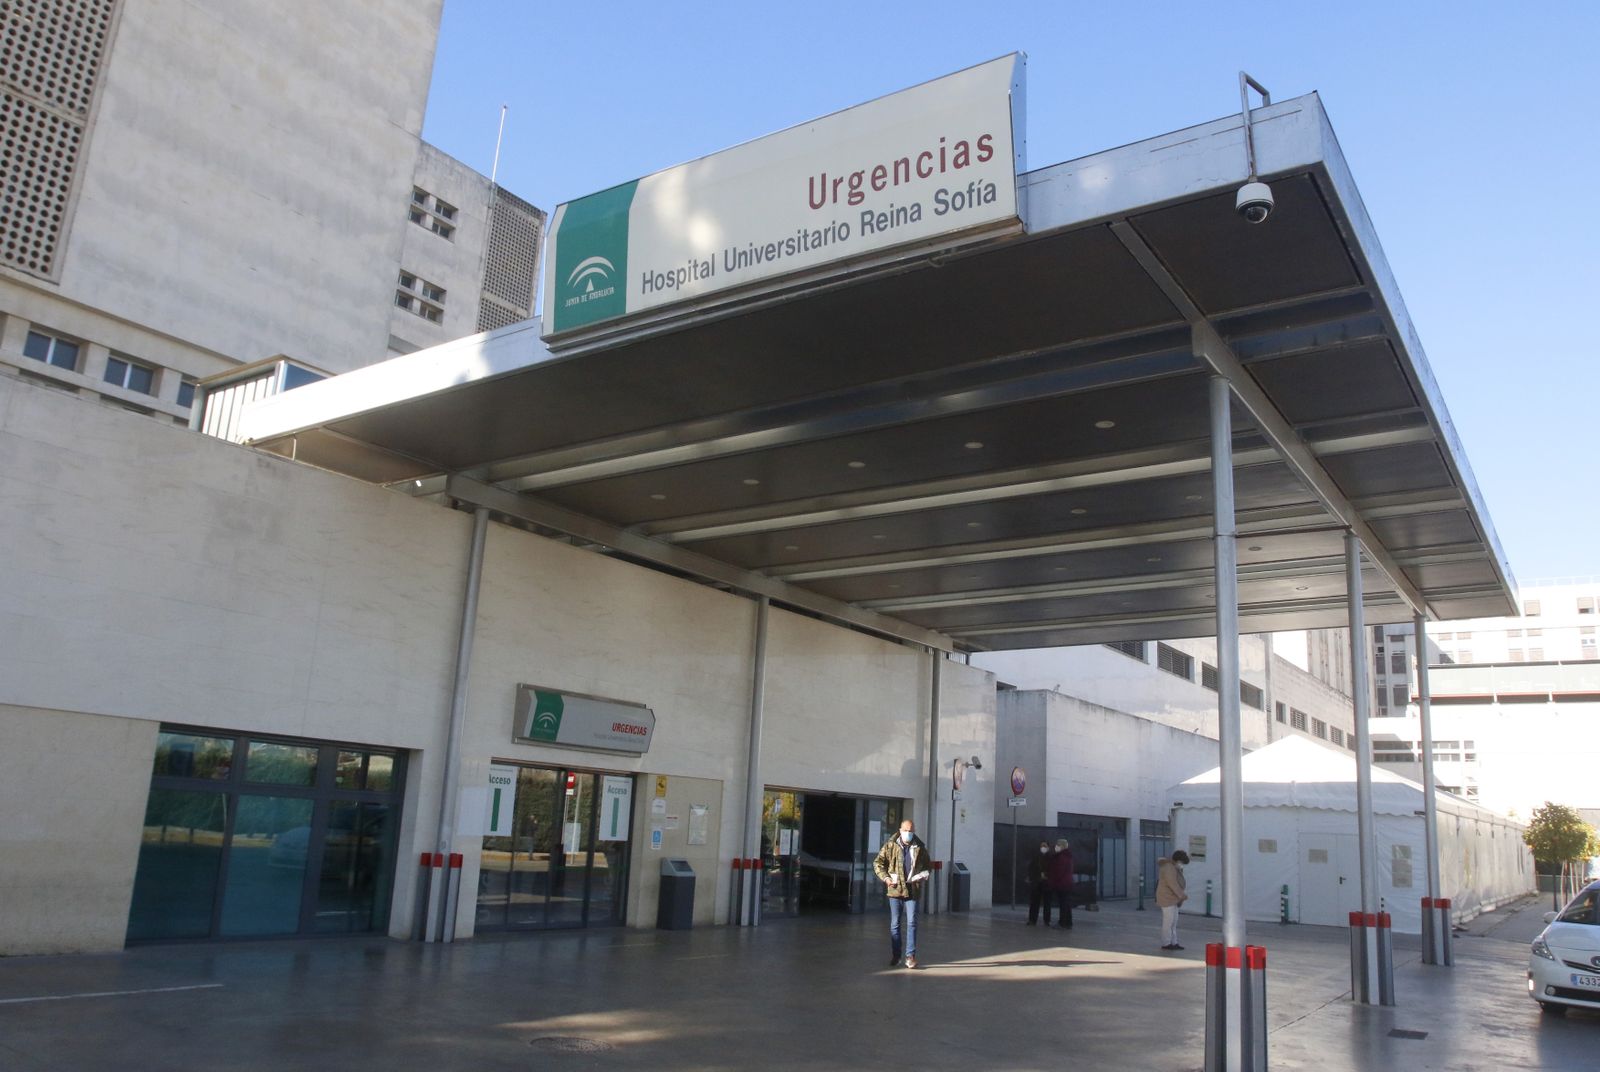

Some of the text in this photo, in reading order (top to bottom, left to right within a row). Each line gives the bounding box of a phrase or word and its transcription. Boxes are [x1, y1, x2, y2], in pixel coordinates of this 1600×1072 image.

[808, 133, 994, 210] Urgencias
[641, 178, 997, 295] Hospital Universitario Reina Sofía
[612, 722, 648, 736] URGENCIAS
[606, 784, 628, 796] Acceso
